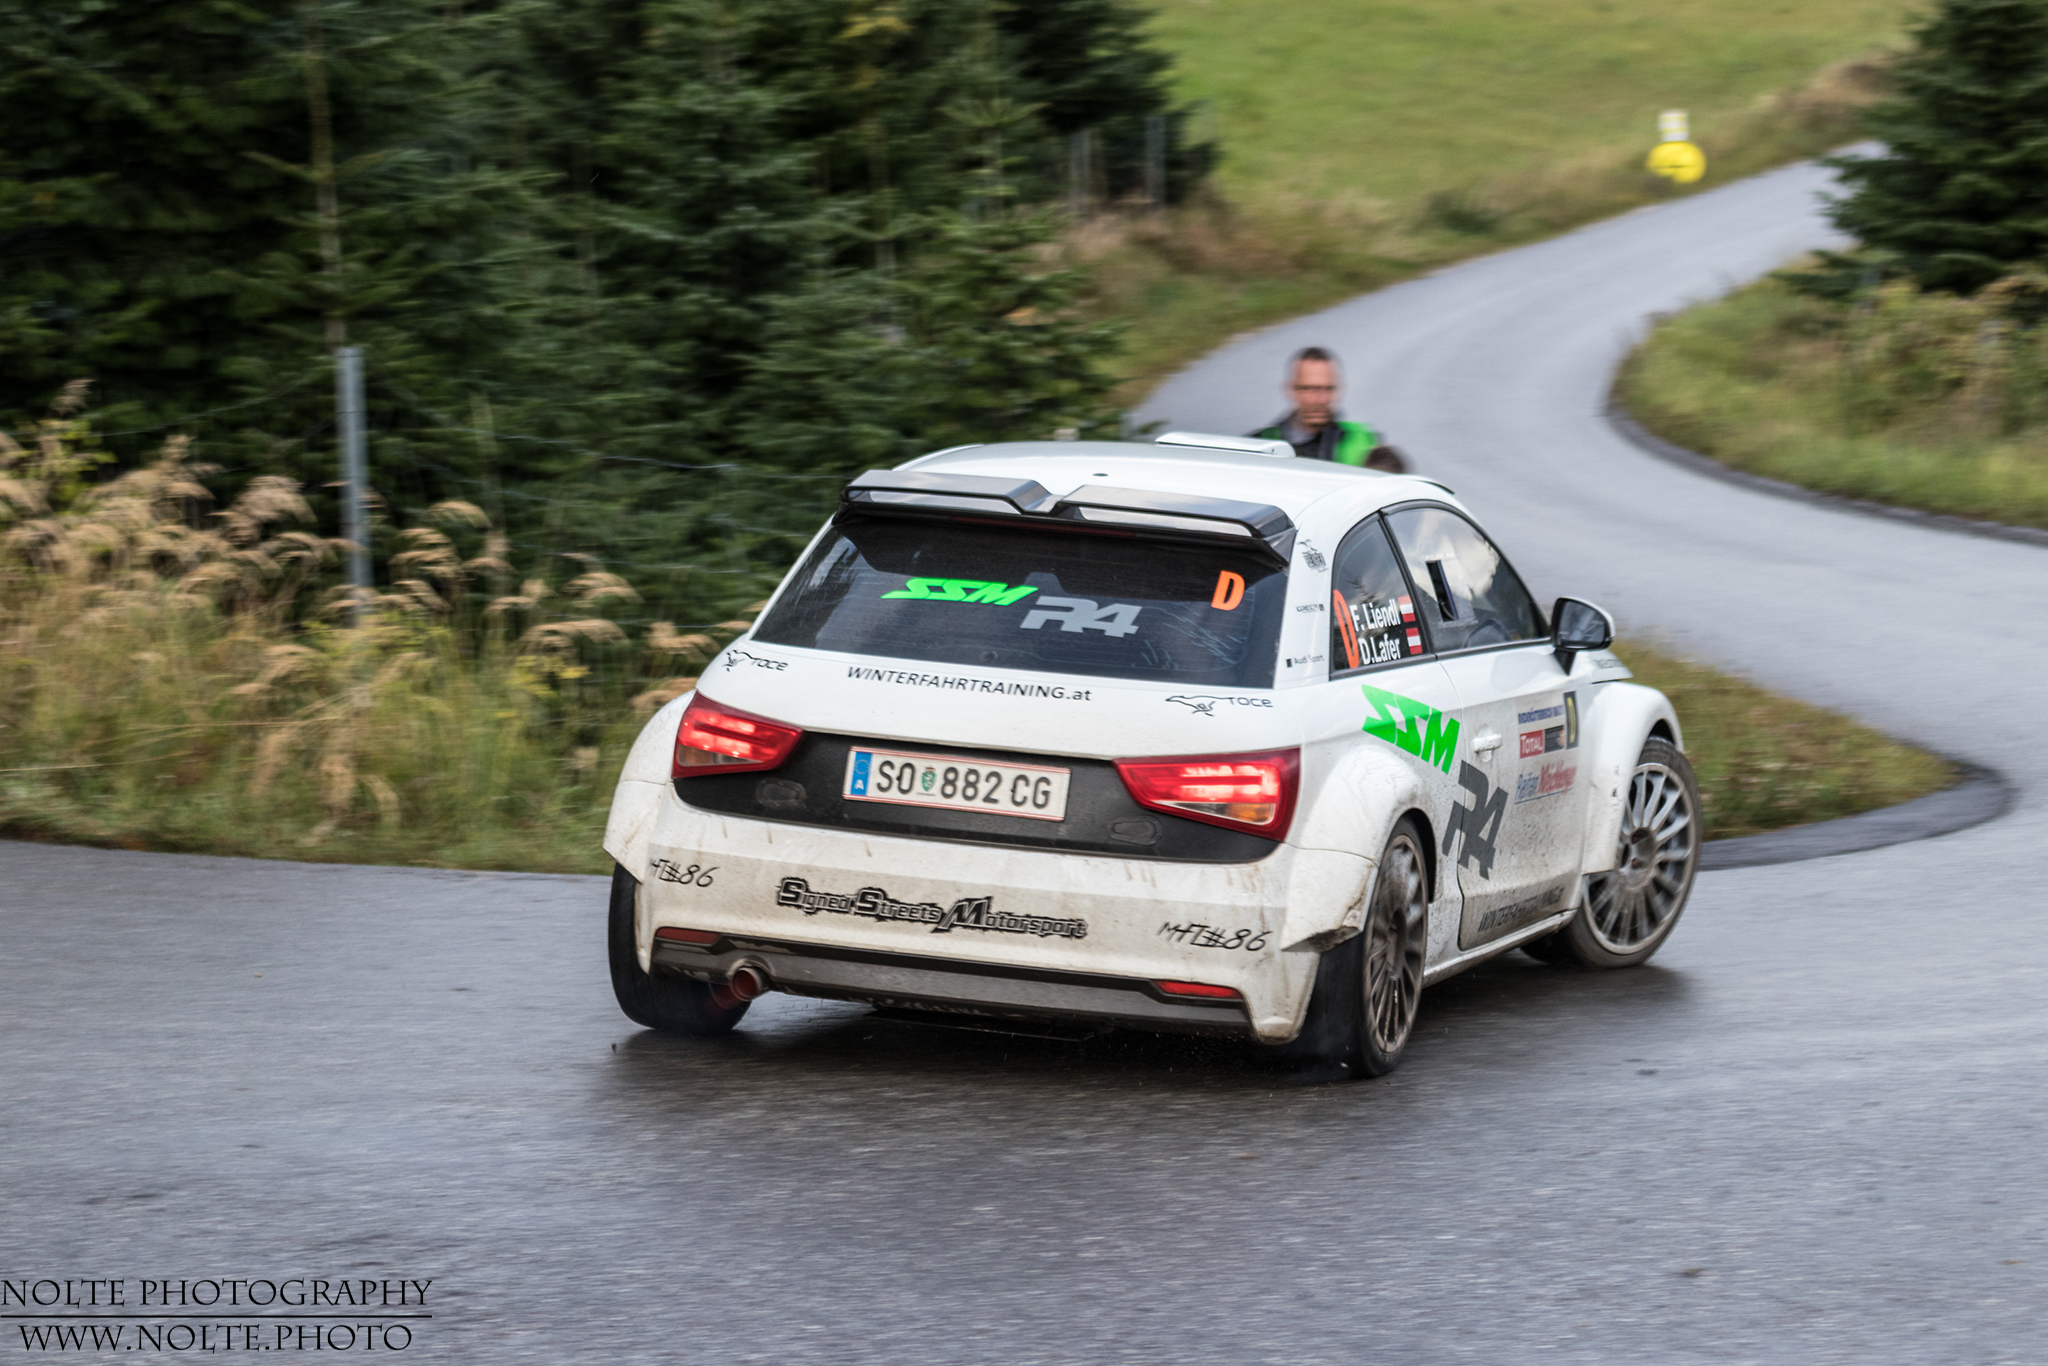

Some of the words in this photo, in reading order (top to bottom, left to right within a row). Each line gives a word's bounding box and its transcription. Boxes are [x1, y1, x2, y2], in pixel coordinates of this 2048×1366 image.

[881, 577, 1038, 606] SSM
[1211, 570, 1245, 611] D
[1349, 604, 1365, 632] F.
[1362, 598, 1401, 630] Liendl
[847, 666, 1093, 701] WINTERFAHRTRAINING.at
[1361, 684, 1461, 775] SSM
[877, 760, 916, 795] SO
[778, 877, 855, 915] Signed
[853, 887, 943, 922] Streets
[931, 896, 1089, 939] Motorsport
